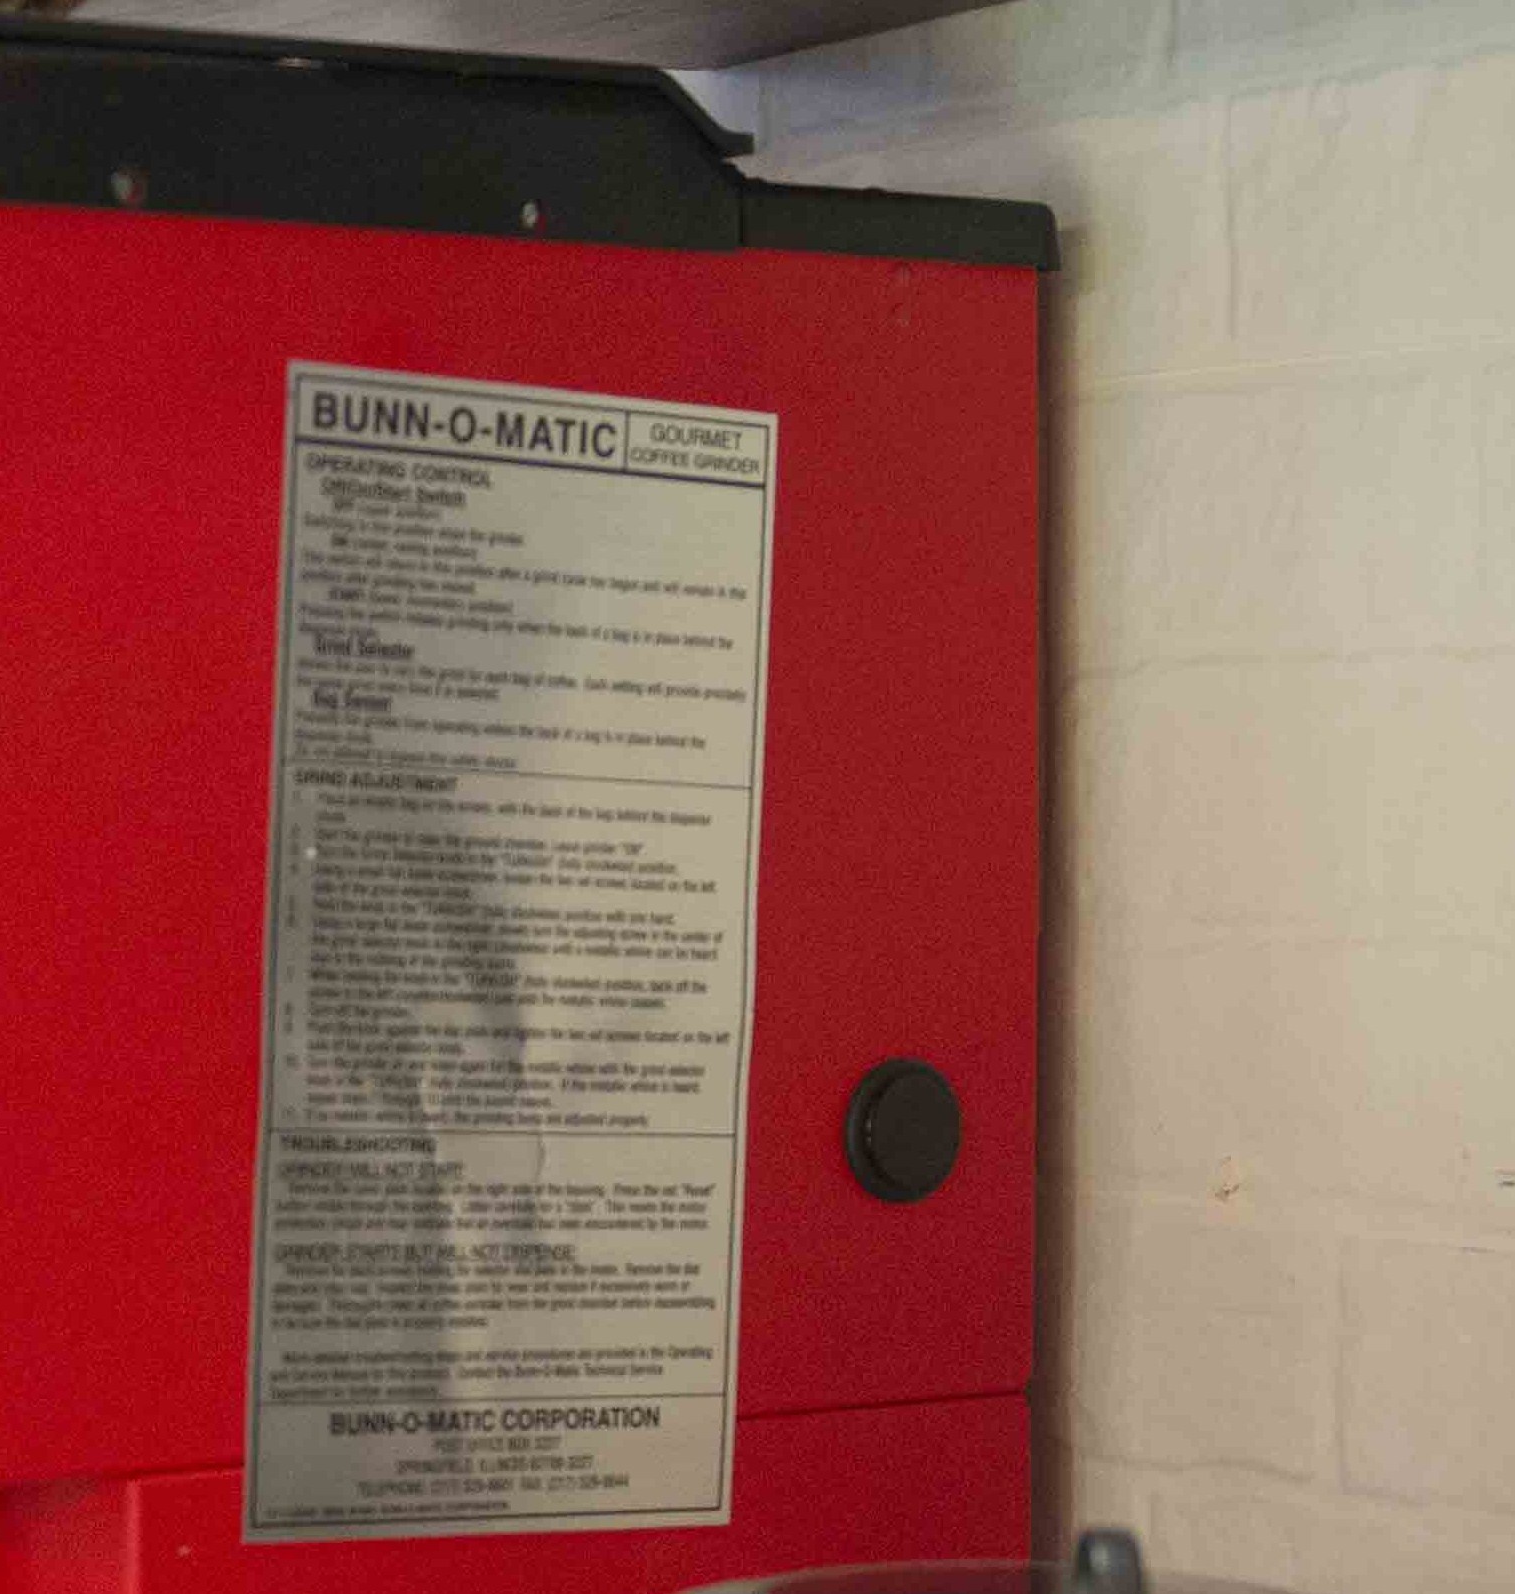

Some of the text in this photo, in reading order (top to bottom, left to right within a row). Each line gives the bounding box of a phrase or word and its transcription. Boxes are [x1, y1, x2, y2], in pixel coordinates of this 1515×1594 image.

[312, 391, 617, 458] BUNN-O-MATIC
[649, 422, 744, 451] GOURMET
[629, 446, 761, 474] COFFEE GRINDER
[329, 1405, 662, 1437] BUNN-O-MATIC CORPORATION
